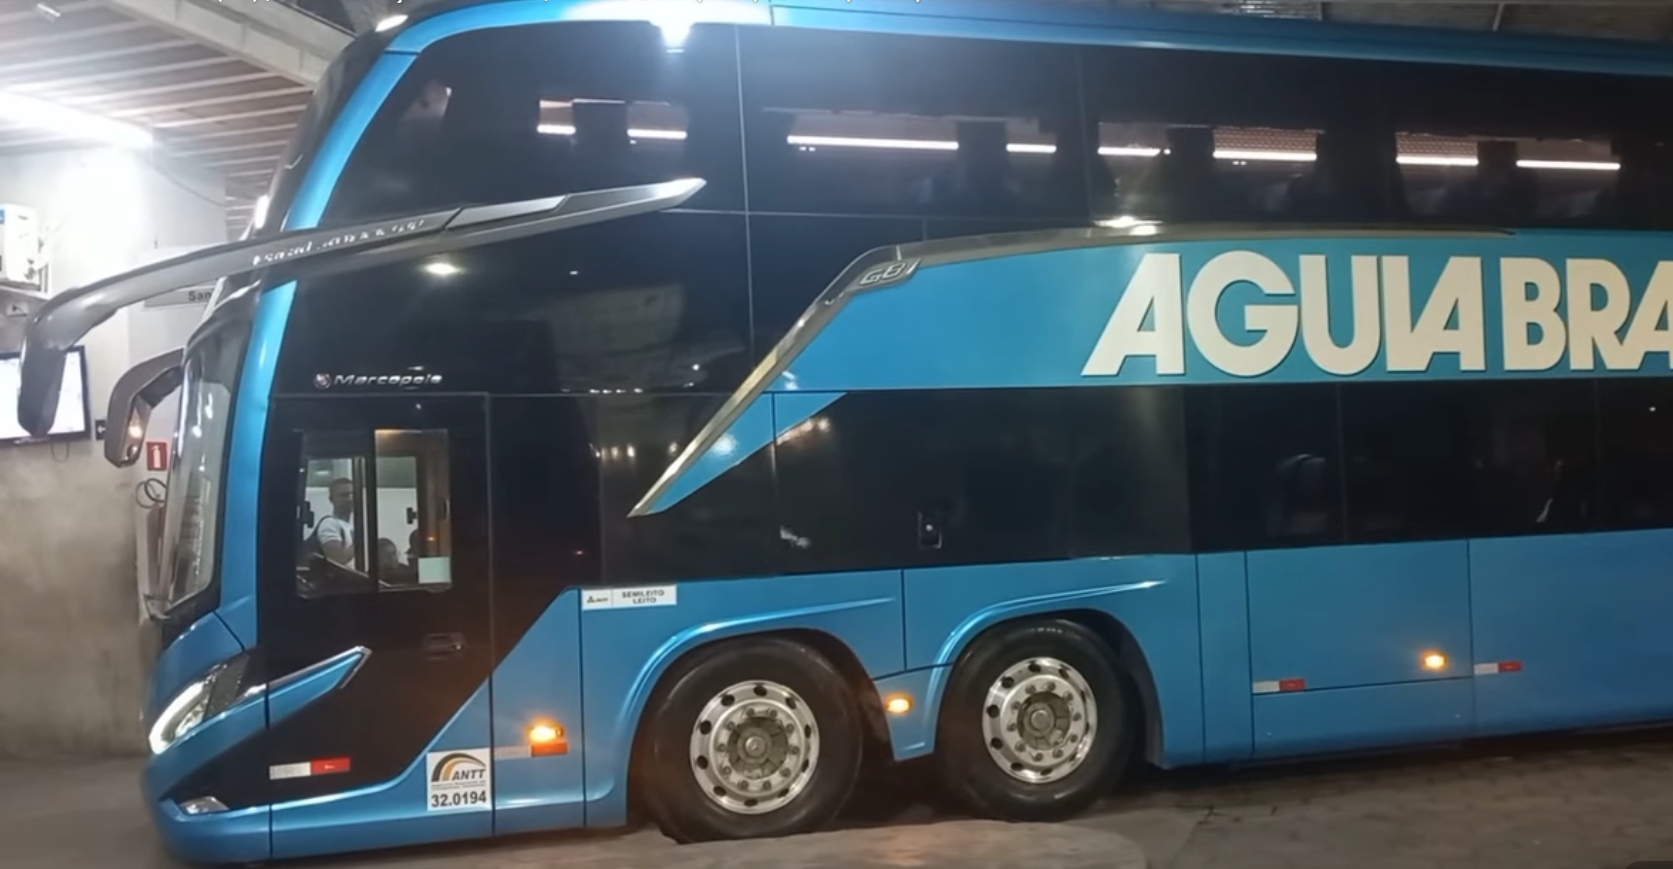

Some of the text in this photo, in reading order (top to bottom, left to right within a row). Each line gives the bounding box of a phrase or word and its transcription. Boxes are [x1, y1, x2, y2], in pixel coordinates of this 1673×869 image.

[188, 288, 214, 302] San
[1081, 250, 1673, 377] AGUIA BRA
[333, 374, 443, 387] Marcopolo
[621, 589, 665, 599] SEMILEITO
[632, 596, 657, 605] LEITO
[451, 768, 487, 782] ANTT
[431, 789, 487, 808] 32.0194
